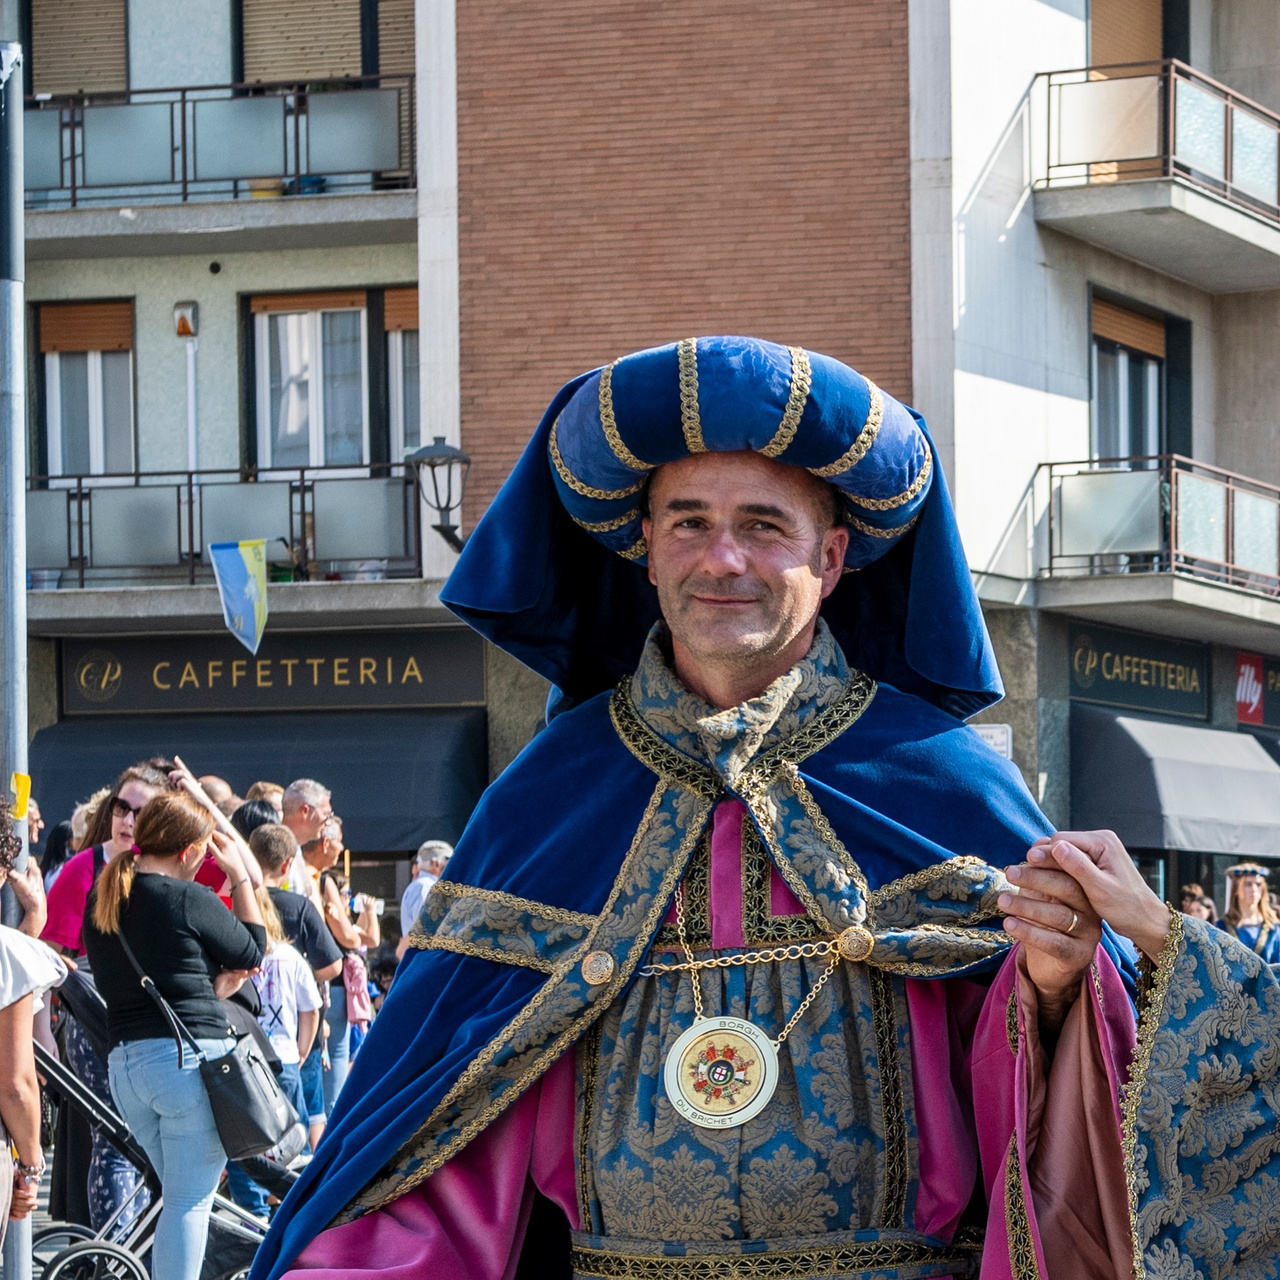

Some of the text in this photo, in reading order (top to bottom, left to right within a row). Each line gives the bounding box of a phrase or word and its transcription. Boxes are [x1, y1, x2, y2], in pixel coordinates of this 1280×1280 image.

[152, 656, 424, 690] CAFFETTERIA
[1101, 651, 1200, 693] CAFFETTERIA
[1236, 663, 1262, 714] illy
[719, 1020, 759, 1039] BORGH
[676, 1098, 733, 1125] DIJ BRICHET
